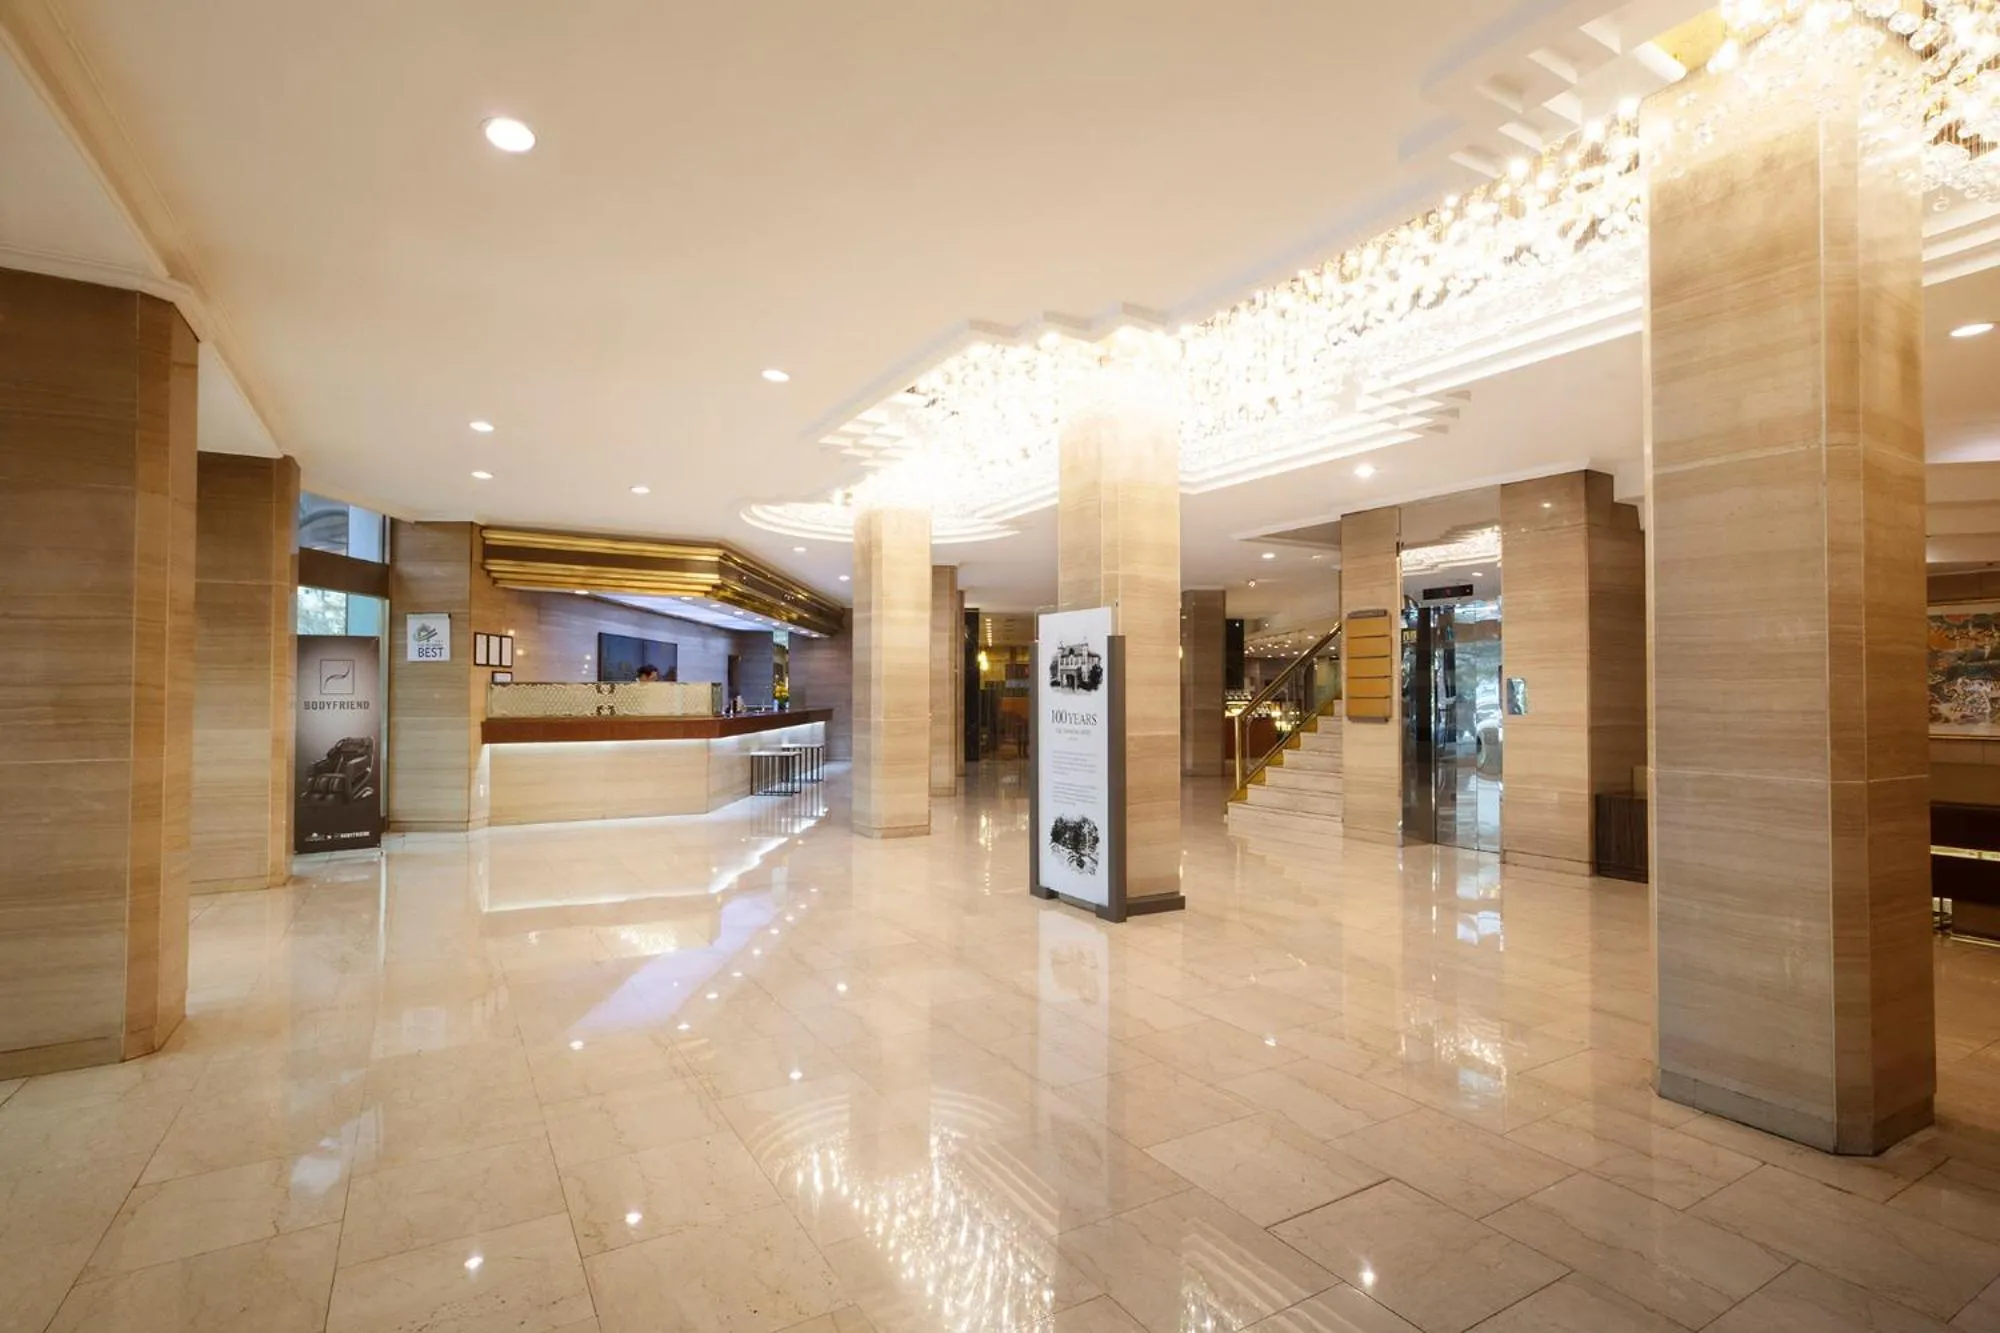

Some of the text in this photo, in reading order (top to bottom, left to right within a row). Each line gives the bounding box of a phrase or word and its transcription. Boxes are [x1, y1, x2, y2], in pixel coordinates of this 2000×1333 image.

[418, 647, 443, 658] BEST
[303, 700, 370, 711] BODYFRIEND
[1068, 712, 1098, 726] YEARS
